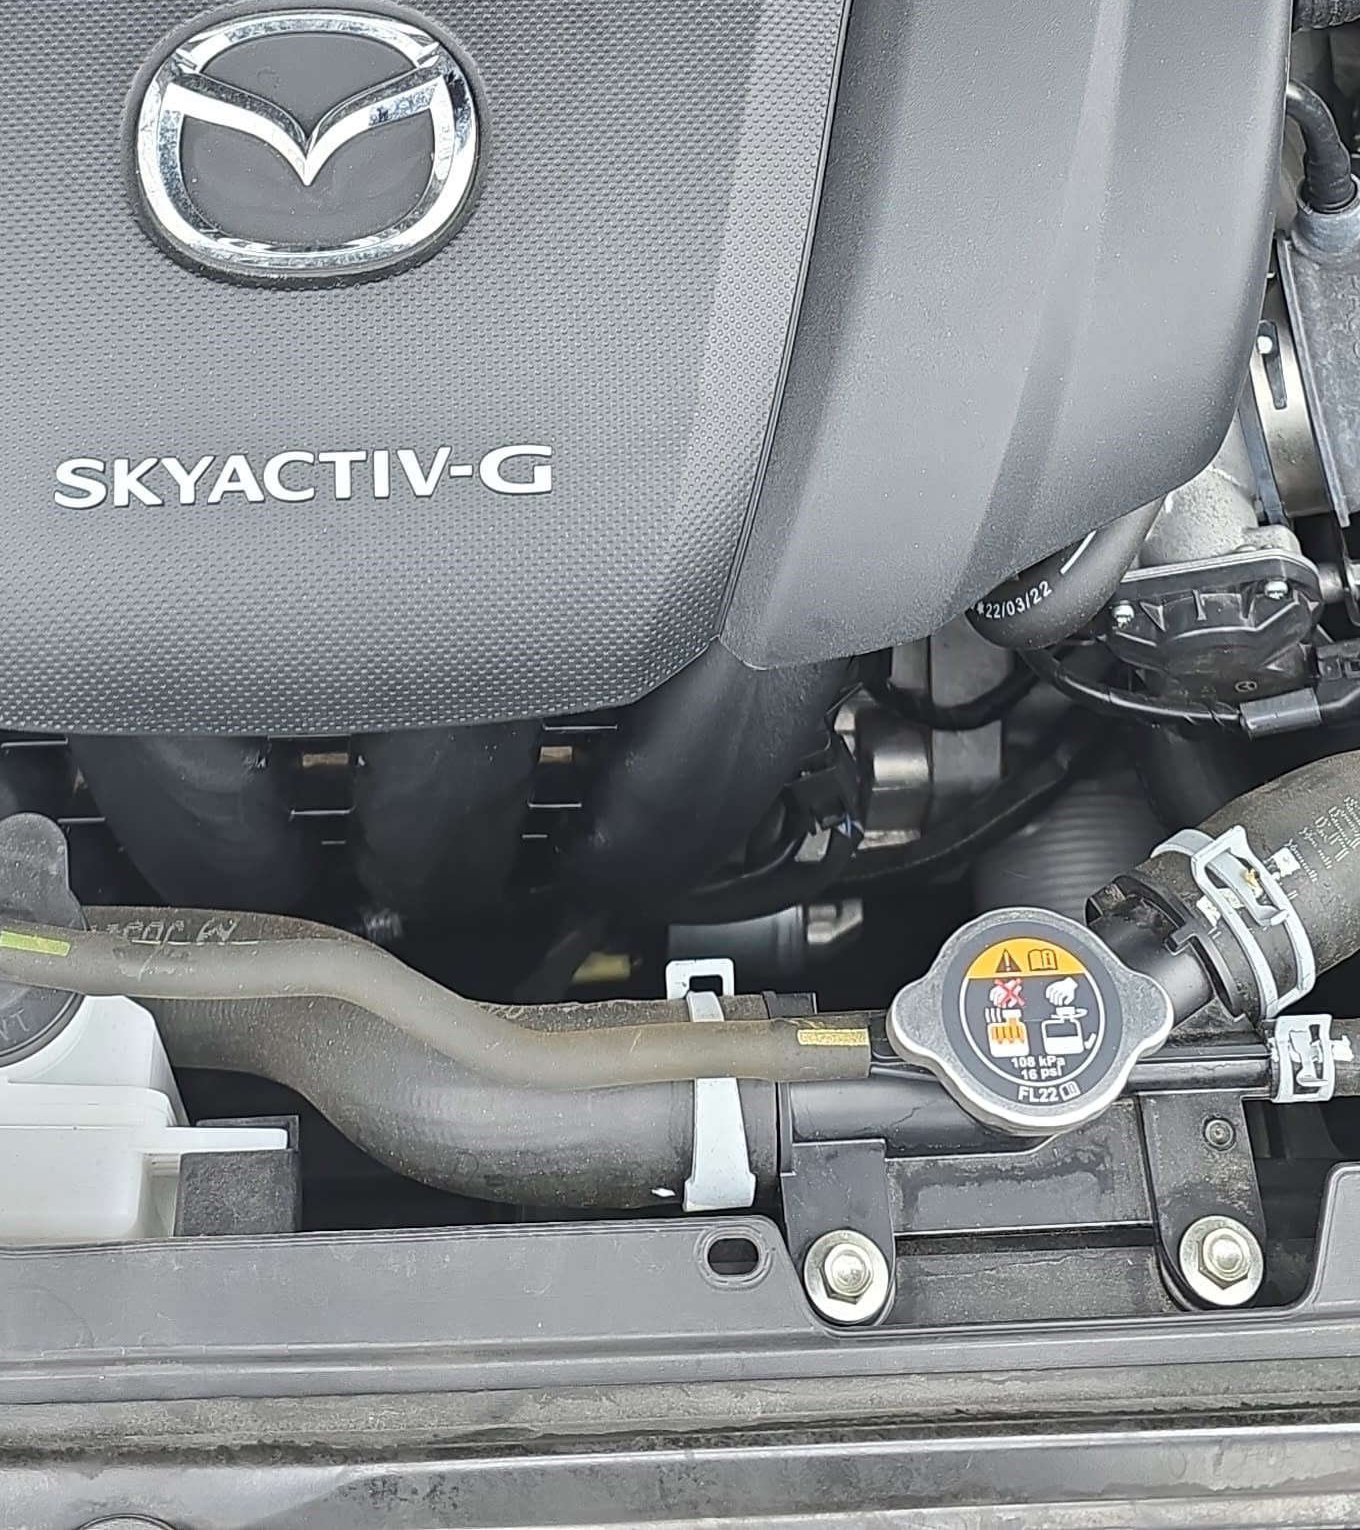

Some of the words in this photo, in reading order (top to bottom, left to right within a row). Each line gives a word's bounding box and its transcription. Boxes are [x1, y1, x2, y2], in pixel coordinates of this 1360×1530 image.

[53, 444, 554, 509] SKYACTIV-G
[1010, 1056, 1035, 1068] 108
[1038, 1055, 1065, 1067] kPa
[1020, 1068, 1037, 1080] 16
[1040, 1065, 1062, 1079] psi
[1017, 1085, 1058, 1102] FL22
